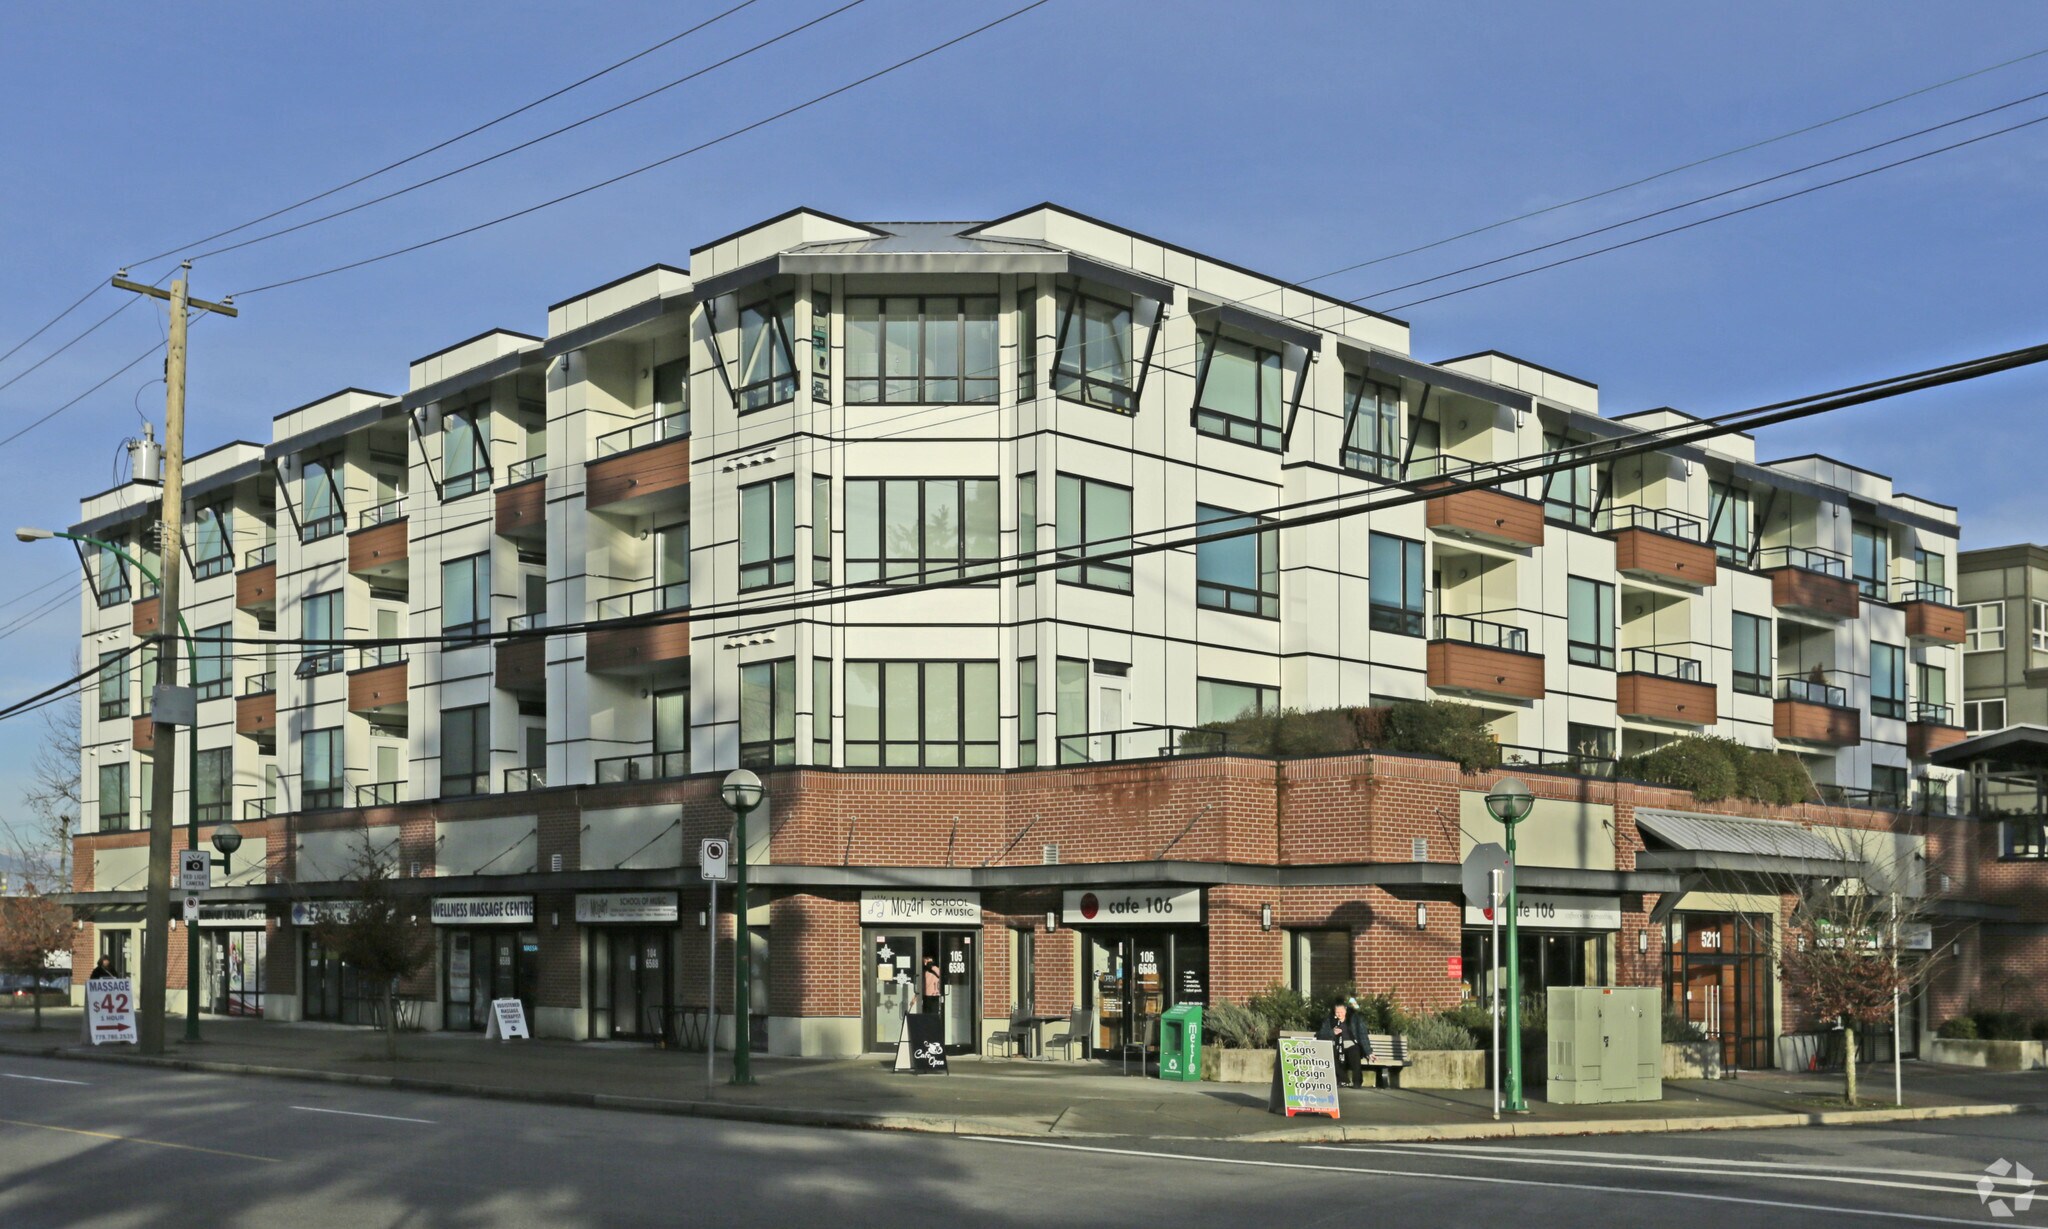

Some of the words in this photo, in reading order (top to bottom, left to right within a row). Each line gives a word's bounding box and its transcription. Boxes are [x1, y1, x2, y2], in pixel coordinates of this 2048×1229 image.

[620, 897, 640, 905] SCHOOL
[641, 897, 649, 905] OF
[650, 896, 666, 905] MUSIC
[1109, 897, 1139, 914] cafe
[1145, 897, 1173, 914] 106
[432, 903, 467, 917] WELLNESS
[469, 902, 503, 917] MASSAGE
[505, 901, 533, 916] CENTRE
[891, 897, 924, 917] Mozart
[930, 898, 968, 906] SCHOOL
[930, 908, 943, 916] OF
[945, 908, 974, 917] MUSIC
[1534, 902, 1555, 919] 106
[1701, 931, 1721, 948] 5211
[950, 950, 963, 962] 105
[1140, 951, 1154, 963] 106
[948, 962, 965, 973] 6588
[1138, 963, 1158, 975] 6588
[89, 981, 130, 992] MASSAGE
[93, 993, 130, 1014] $42
[1188, 1024, 1198, 1074] metro
[1291, 1046, 1316, 1055] signs
[929, 1056, 945, 1068] Open
[1292, 1058, 1330, 1068] printing
[1294, 1069, 1325, 1079] design
[1295, 1081, 1331, 1092] copying
